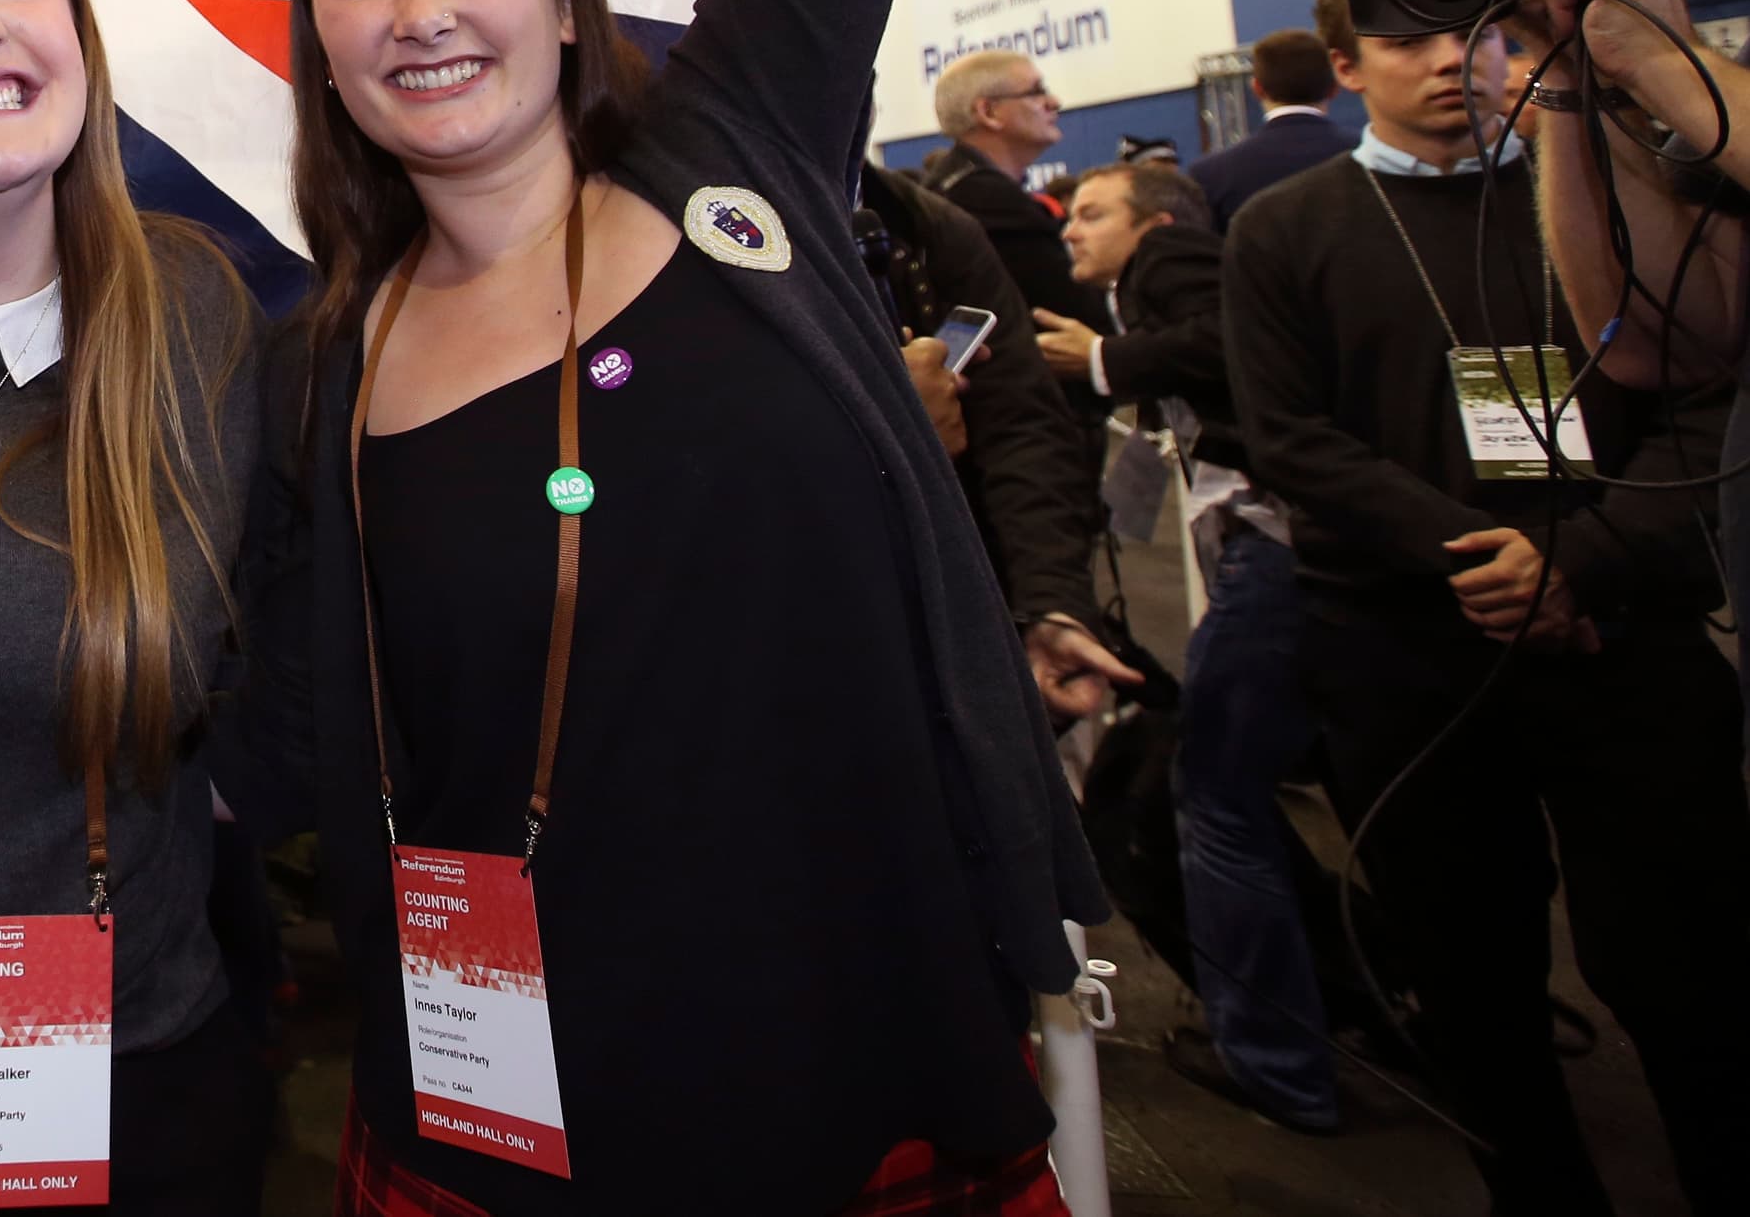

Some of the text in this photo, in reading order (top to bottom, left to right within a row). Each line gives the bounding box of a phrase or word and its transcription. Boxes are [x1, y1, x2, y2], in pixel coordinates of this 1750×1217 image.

[590, 353, 622, 380] NO
[597, 364, 627, 385] THANKS
[551, 477, 586, 498] NO
[555, 495, 589, 506] THANKS
[401, 859, 465, 876] Referendum
[434, 874, 466, 885] Edinburgh
[404, 890, 470, 914] COUNTING
[406, 910, 448, 931] AGENT
[412, 980, 429, 990] Name
[414, 997, 477, 1022] Innes Taylor
[418, 1041, 490, 1069] Conservative Party
[0, 1111, 26, 1121] Party
[421, 1109, 535, 1153] HIGHLAND HALL ONLY
[2, 1177, 38, 1191] HALL
[40, 1175, 78, 1189] ONLY
